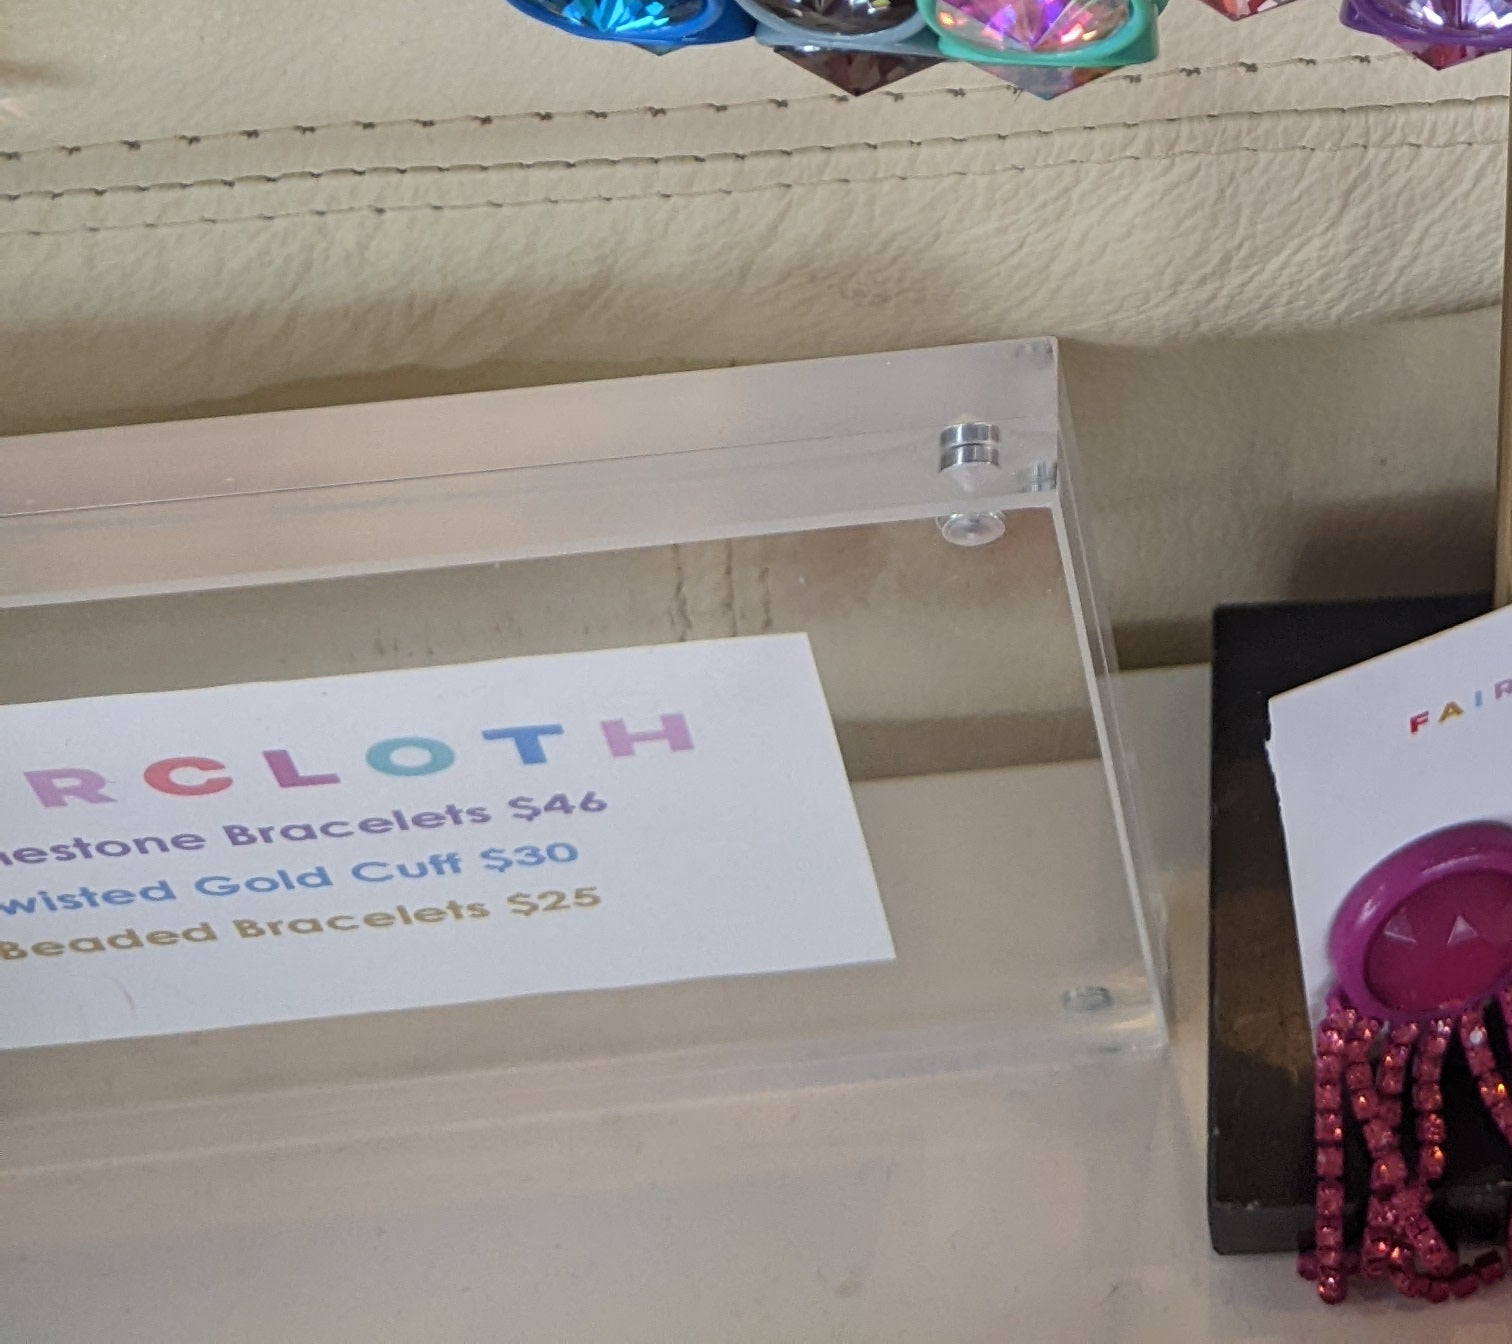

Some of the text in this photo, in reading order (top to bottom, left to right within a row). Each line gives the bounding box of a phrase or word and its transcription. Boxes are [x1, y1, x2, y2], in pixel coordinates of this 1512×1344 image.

[23, 714, 694, 808] RCLOTH
[222, 804, 492, 847] Bracelets
[508, 791, 608, 822] $46
[0, 842, 579, 916] wisted Gold Cuff $30
[0, 886, 601, 962] Beaded Bracelets $25
